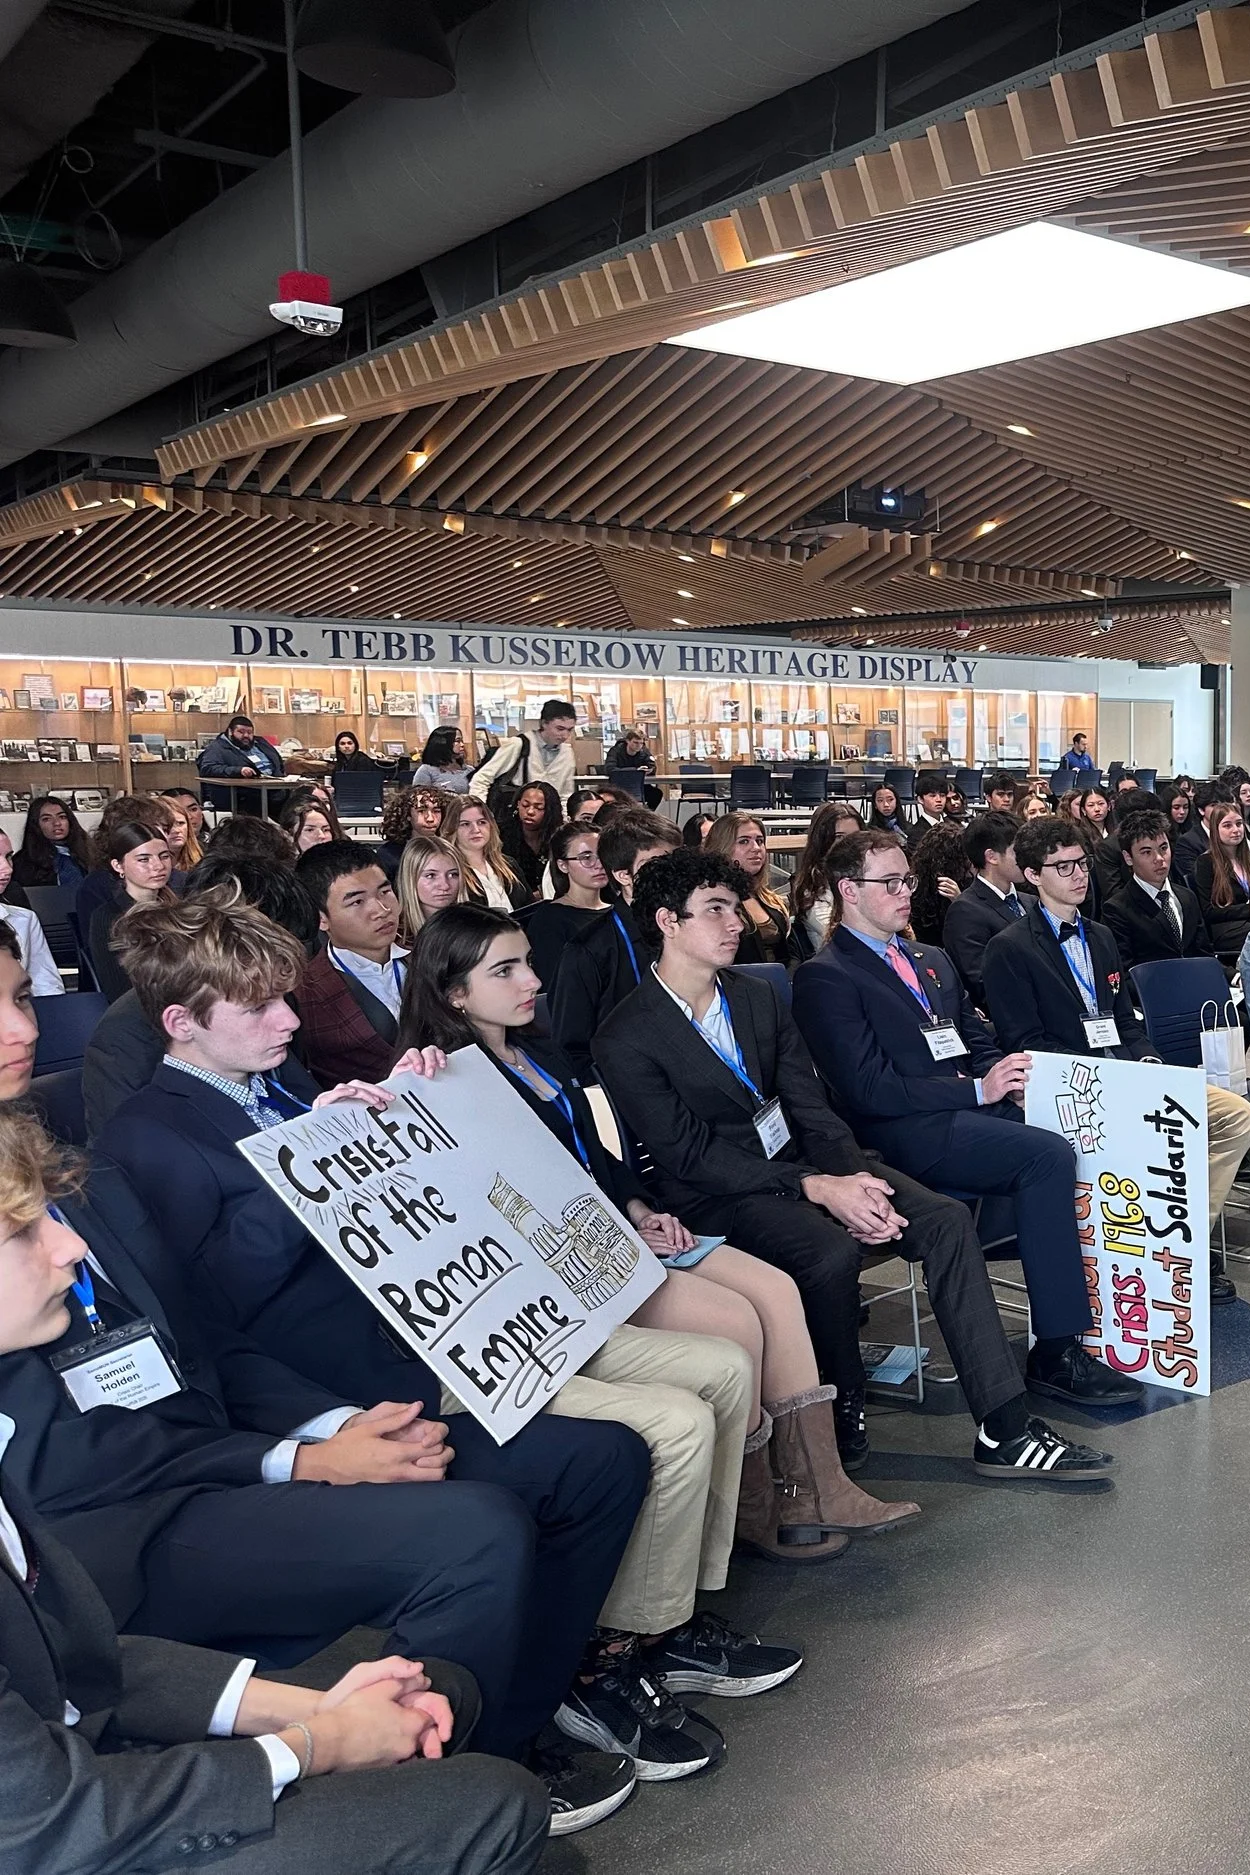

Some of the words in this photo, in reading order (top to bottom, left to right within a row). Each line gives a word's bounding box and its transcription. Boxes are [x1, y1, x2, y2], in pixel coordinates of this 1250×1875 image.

[229, 624, 309, 659] DR.
[321, 629, 436, 663] TEBB
[448, 634, 666, 672] KUSSEROW
[677, 645, 851, 680] HERITAGE
[858, 655, 978, 685] DISPLAY
[378, 1185, 458, 1242] the
[1098, 1171, 1147, 1258] 1968
[1143, 1094, 1201, 1244] Solidarity
[378, 1235, 513, 1341] Roman
[1104, 1262, 1150, 1374] Crisis:
[1151, 1246, 1199, 1388] Student
[94, 1360, 136, 1383] Samuel
[100, 1372, 141, 1393] Holden
[447, 1294, 570, 1398] Empire
